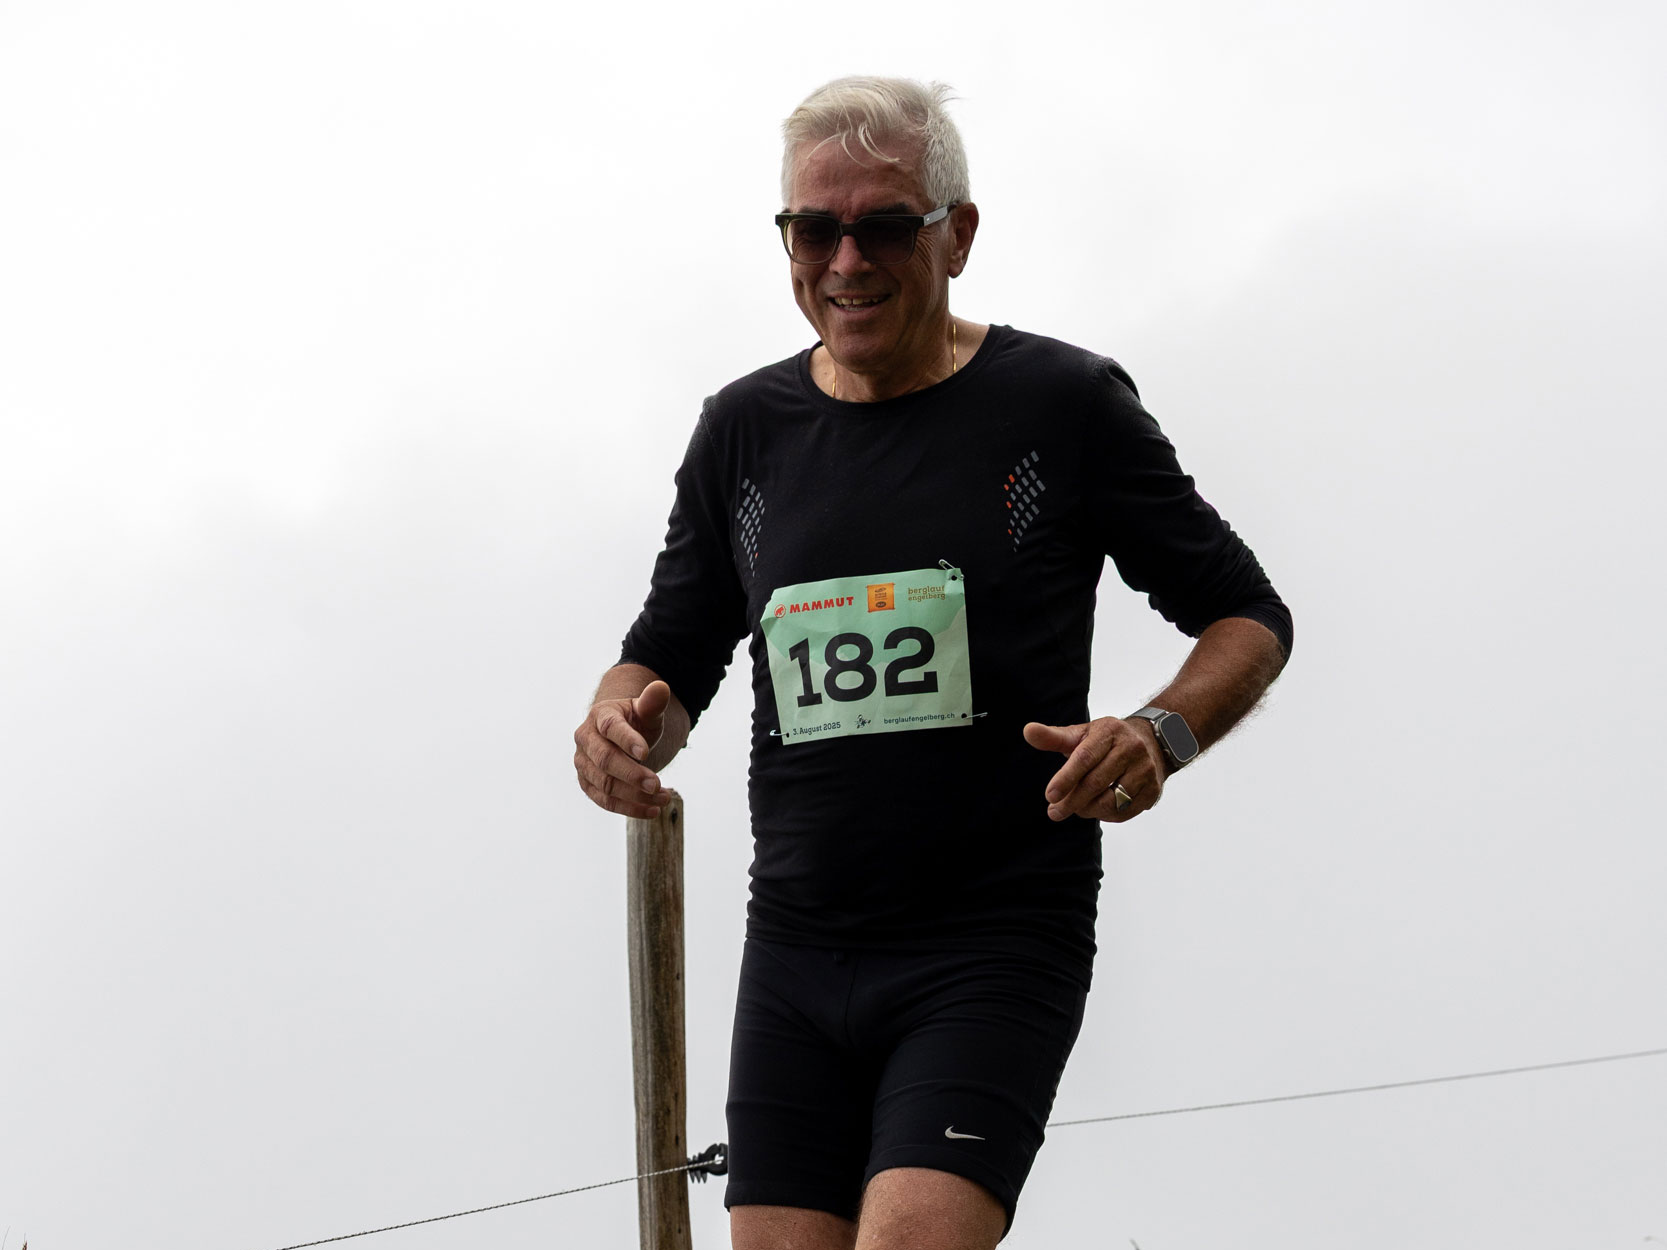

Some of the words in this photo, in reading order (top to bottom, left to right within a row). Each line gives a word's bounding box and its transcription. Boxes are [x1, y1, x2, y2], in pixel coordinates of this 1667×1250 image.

[907, 584, 946, 597] berglauf
[907, 592, 946, 602] engelberg
[790, 596, 854, 614] MAMMUT
[788, 626, 939, 708] 182
[883, 712, 956, 725] berglaufengelberg.ch
[792, 727, 799, 736] 3.
[799, 724, 823, 736] August
[823, 721, 841, 731] 2025
